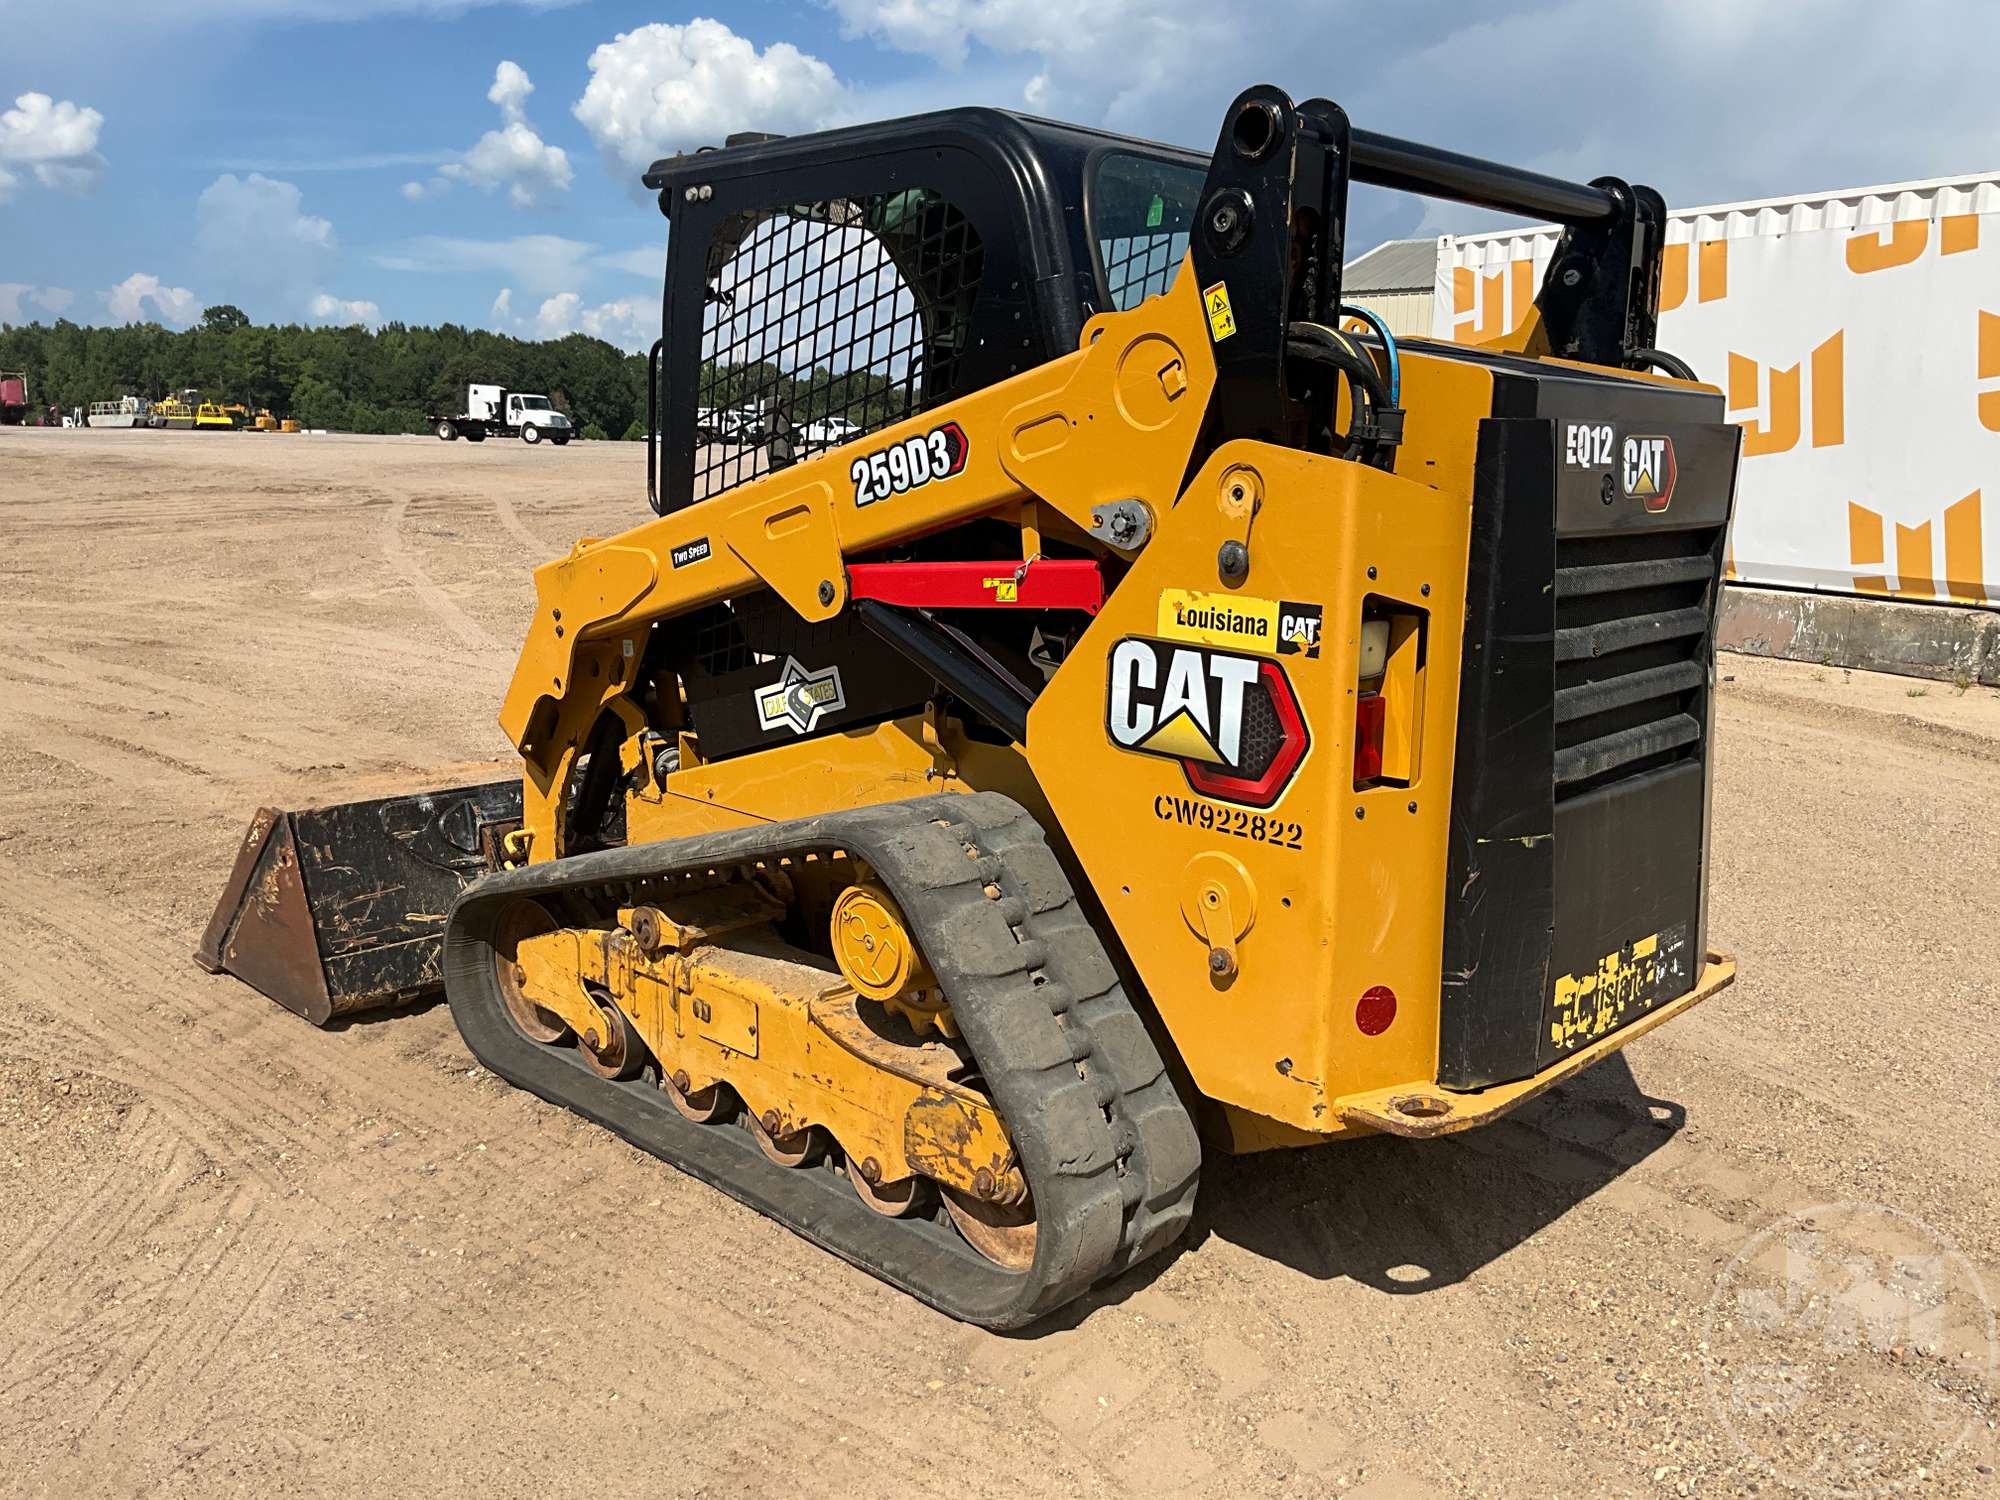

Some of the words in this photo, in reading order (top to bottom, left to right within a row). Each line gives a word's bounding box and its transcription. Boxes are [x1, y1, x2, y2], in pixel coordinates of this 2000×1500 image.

[852, 430, 951, 505] 259D3
[1566, 425, 1613, 468] EQ12
[1624, 437, 1665, 493] CAT
[1176, 606, 1268, 637] Louisiana
[1281, 614, 1317, 646] CAT
[1110, 640, 1260, 767] CAT
[1154, 795, 1302, 850] CW922822
